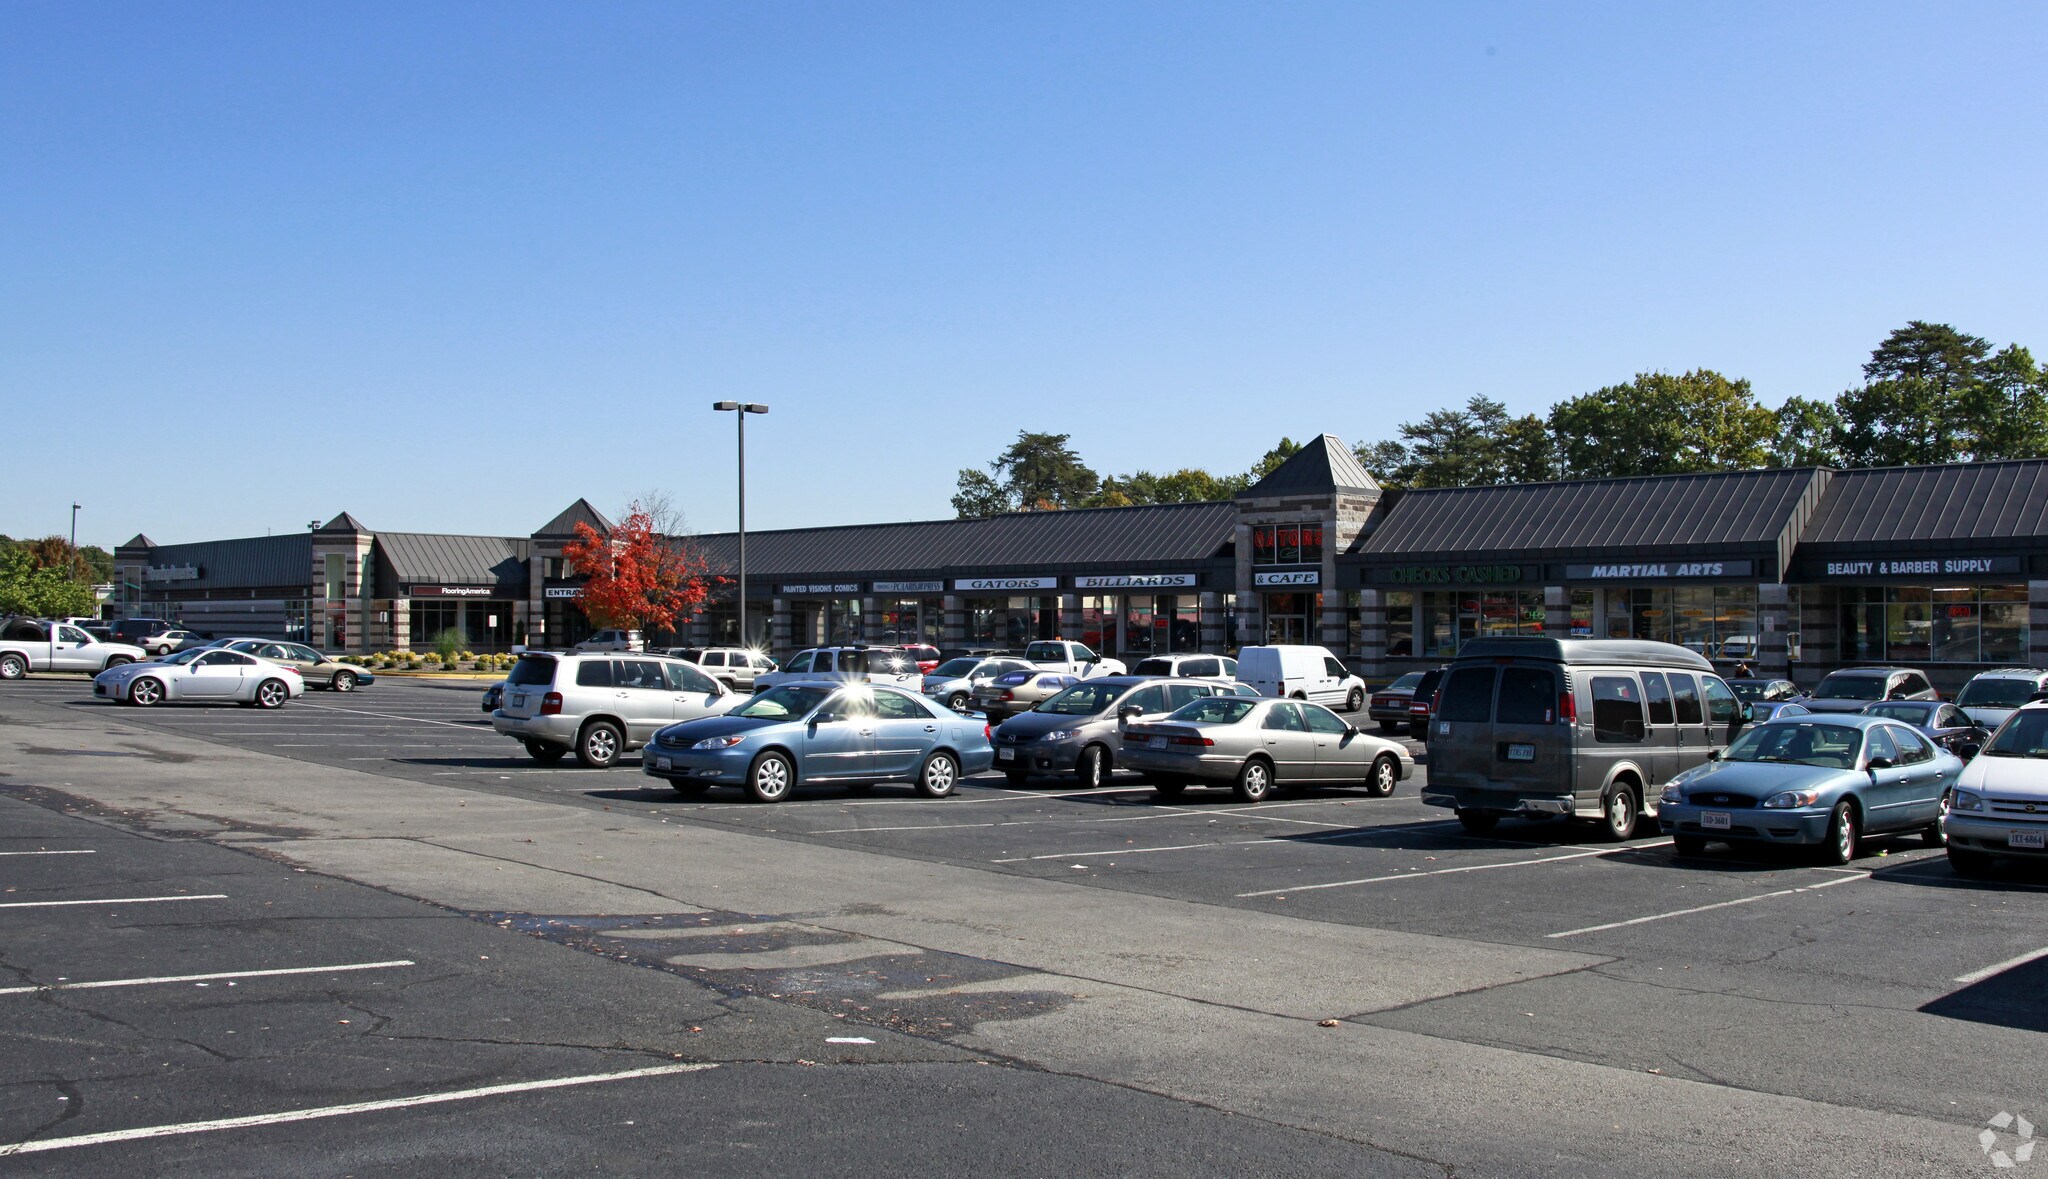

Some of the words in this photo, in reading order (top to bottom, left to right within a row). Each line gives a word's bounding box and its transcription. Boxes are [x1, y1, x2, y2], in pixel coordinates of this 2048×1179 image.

[1591, 564, 1668, 577] MARTIAL
[1676, 563, 1723, 576] ARTS
[1827, 562, 1873, 575] BEAUTY
[1879, 562, 1888, 574] &
[1891, 560, 1939, 573] BARBER
[1945, 560, 1992, 572] SUPPLY
[1257, 575, 1264, 584] &
[1268, 574, 1314, 583] CAFE
[1391, 566, 1450, 583] CHECKS
[1456, 565, 1521, 583] CASHED
[971, 579, 1040, 588] GATORS
[1086, 576, 1185, 587] BILLIARDS
[442, 587, 491, 595] FlooringAmerica
[783, 585, 807, 593] PAINTED
[809, 584, 832, 593] VISIONS
[834, 584, 859, 592] COMICS
